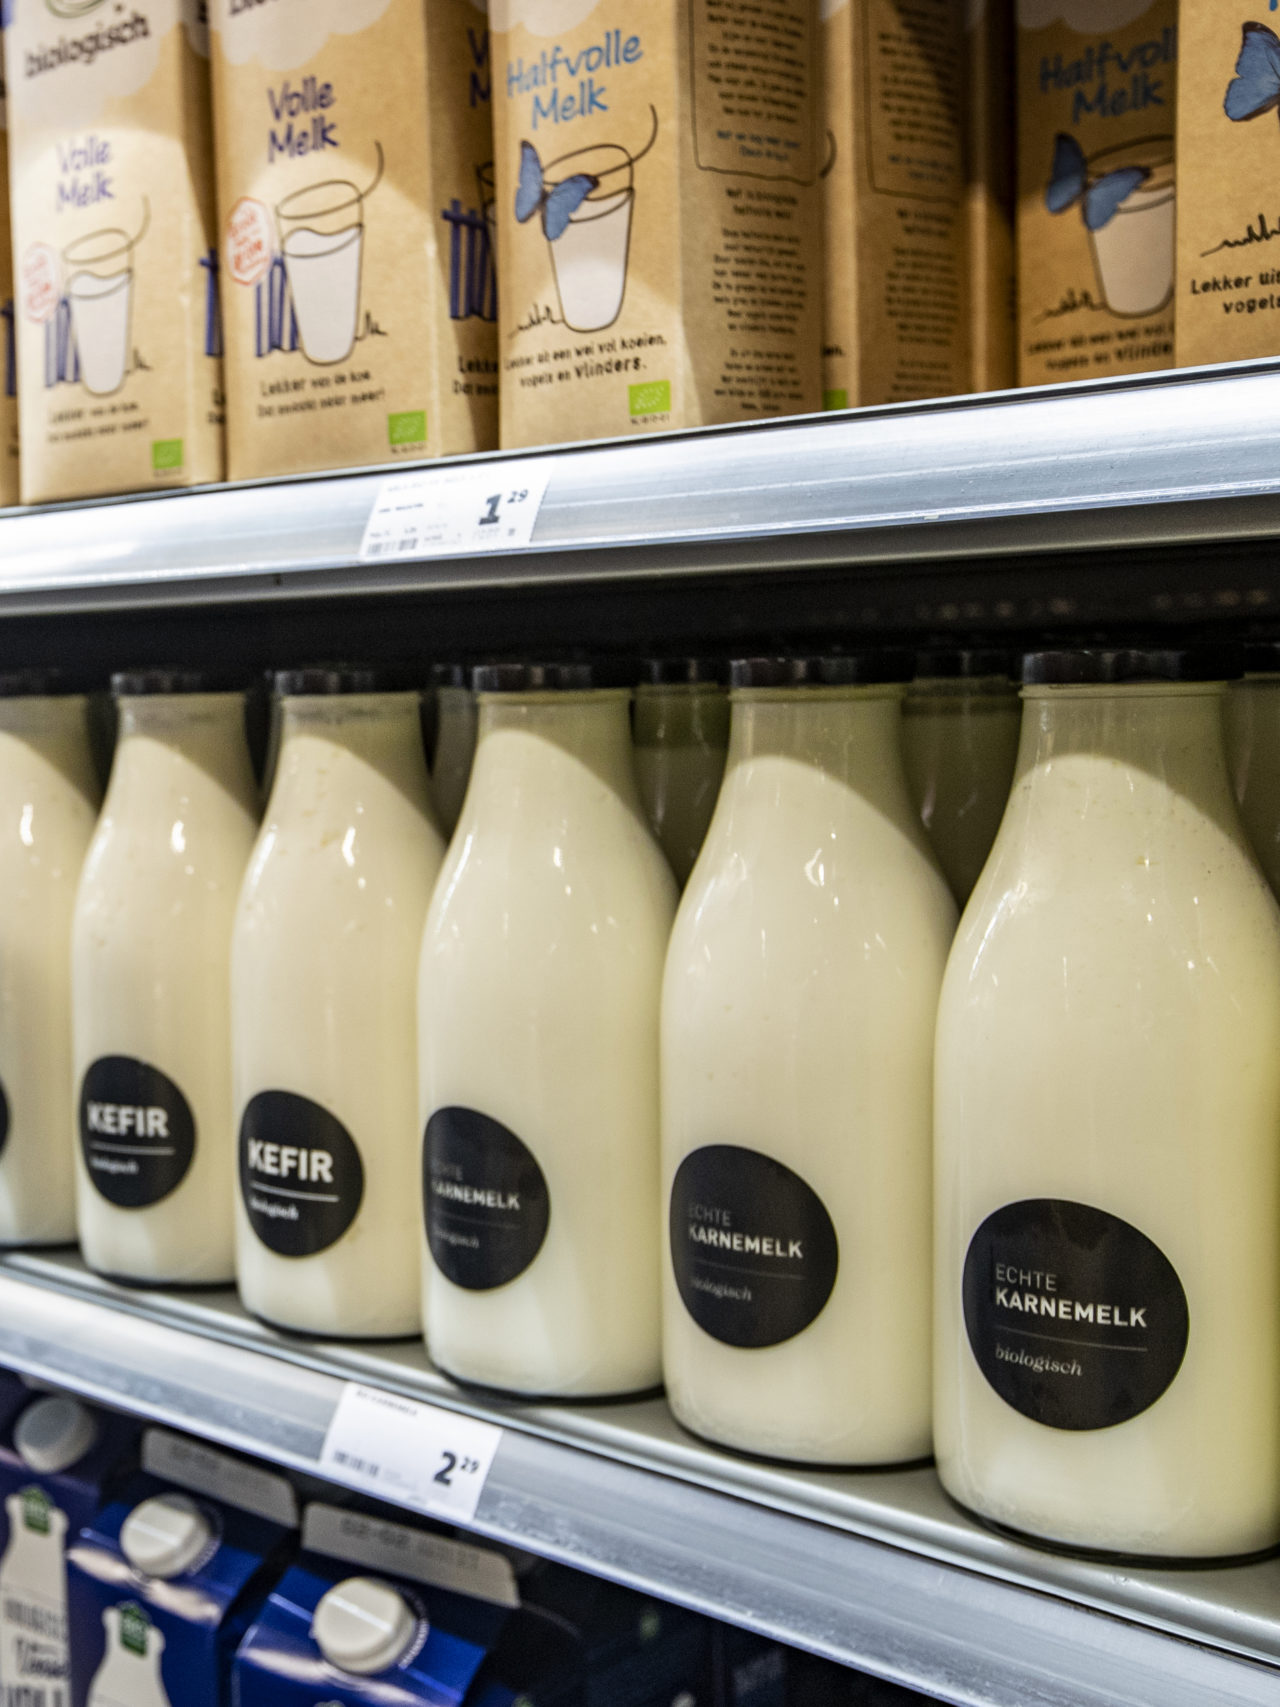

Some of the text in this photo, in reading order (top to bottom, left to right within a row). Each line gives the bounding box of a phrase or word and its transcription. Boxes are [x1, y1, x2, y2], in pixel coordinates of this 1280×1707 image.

[507, 28, 643, 98] Halfvolle
[268, 74, 336, 121] Volle
[531, 80, 608, 130] Melk
[268, 115, 339, 163] Melk
[1191, 274, 1252, 295] Lekker
[478, 488, 529, 526] 1 29
[87, 1100, 170, 1138] KEFIR
[248, 1136, 334, 1184] KEFIR
[688, 1223, 804, 1260] KARNEMELK
[995, 1263, 1057, 1292] ECHTE
[995, 1286, 1147, 1329] KARNEMELK
[995, 1343, 1083, 1376] biologisch
[433, 1451, 480, 1486] 2 29
